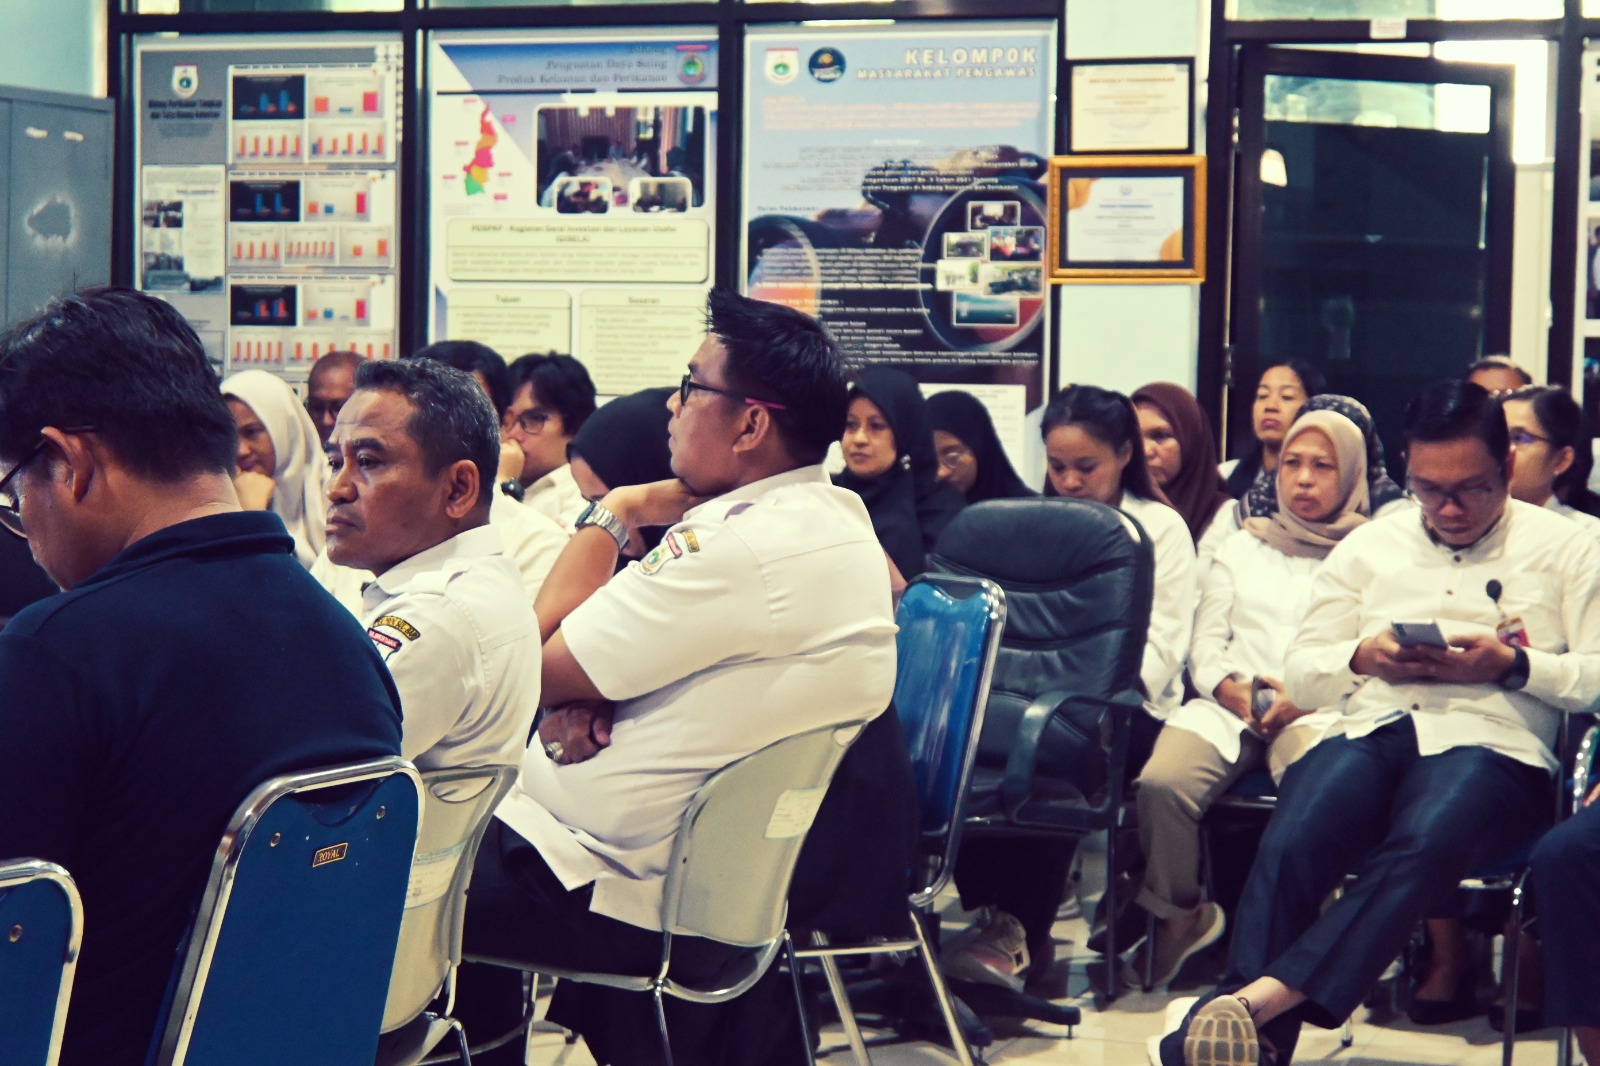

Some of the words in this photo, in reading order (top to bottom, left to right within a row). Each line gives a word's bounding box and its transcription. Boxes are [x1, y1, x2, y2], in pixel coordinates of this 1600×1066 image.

[904, 46, 1037, 65] KELOMPOK
[590, 72, 610, 83] dan
[856, 67, 951, 80] MASYARAKAT
[956, 66, 1036, 78] PENGAWAS
